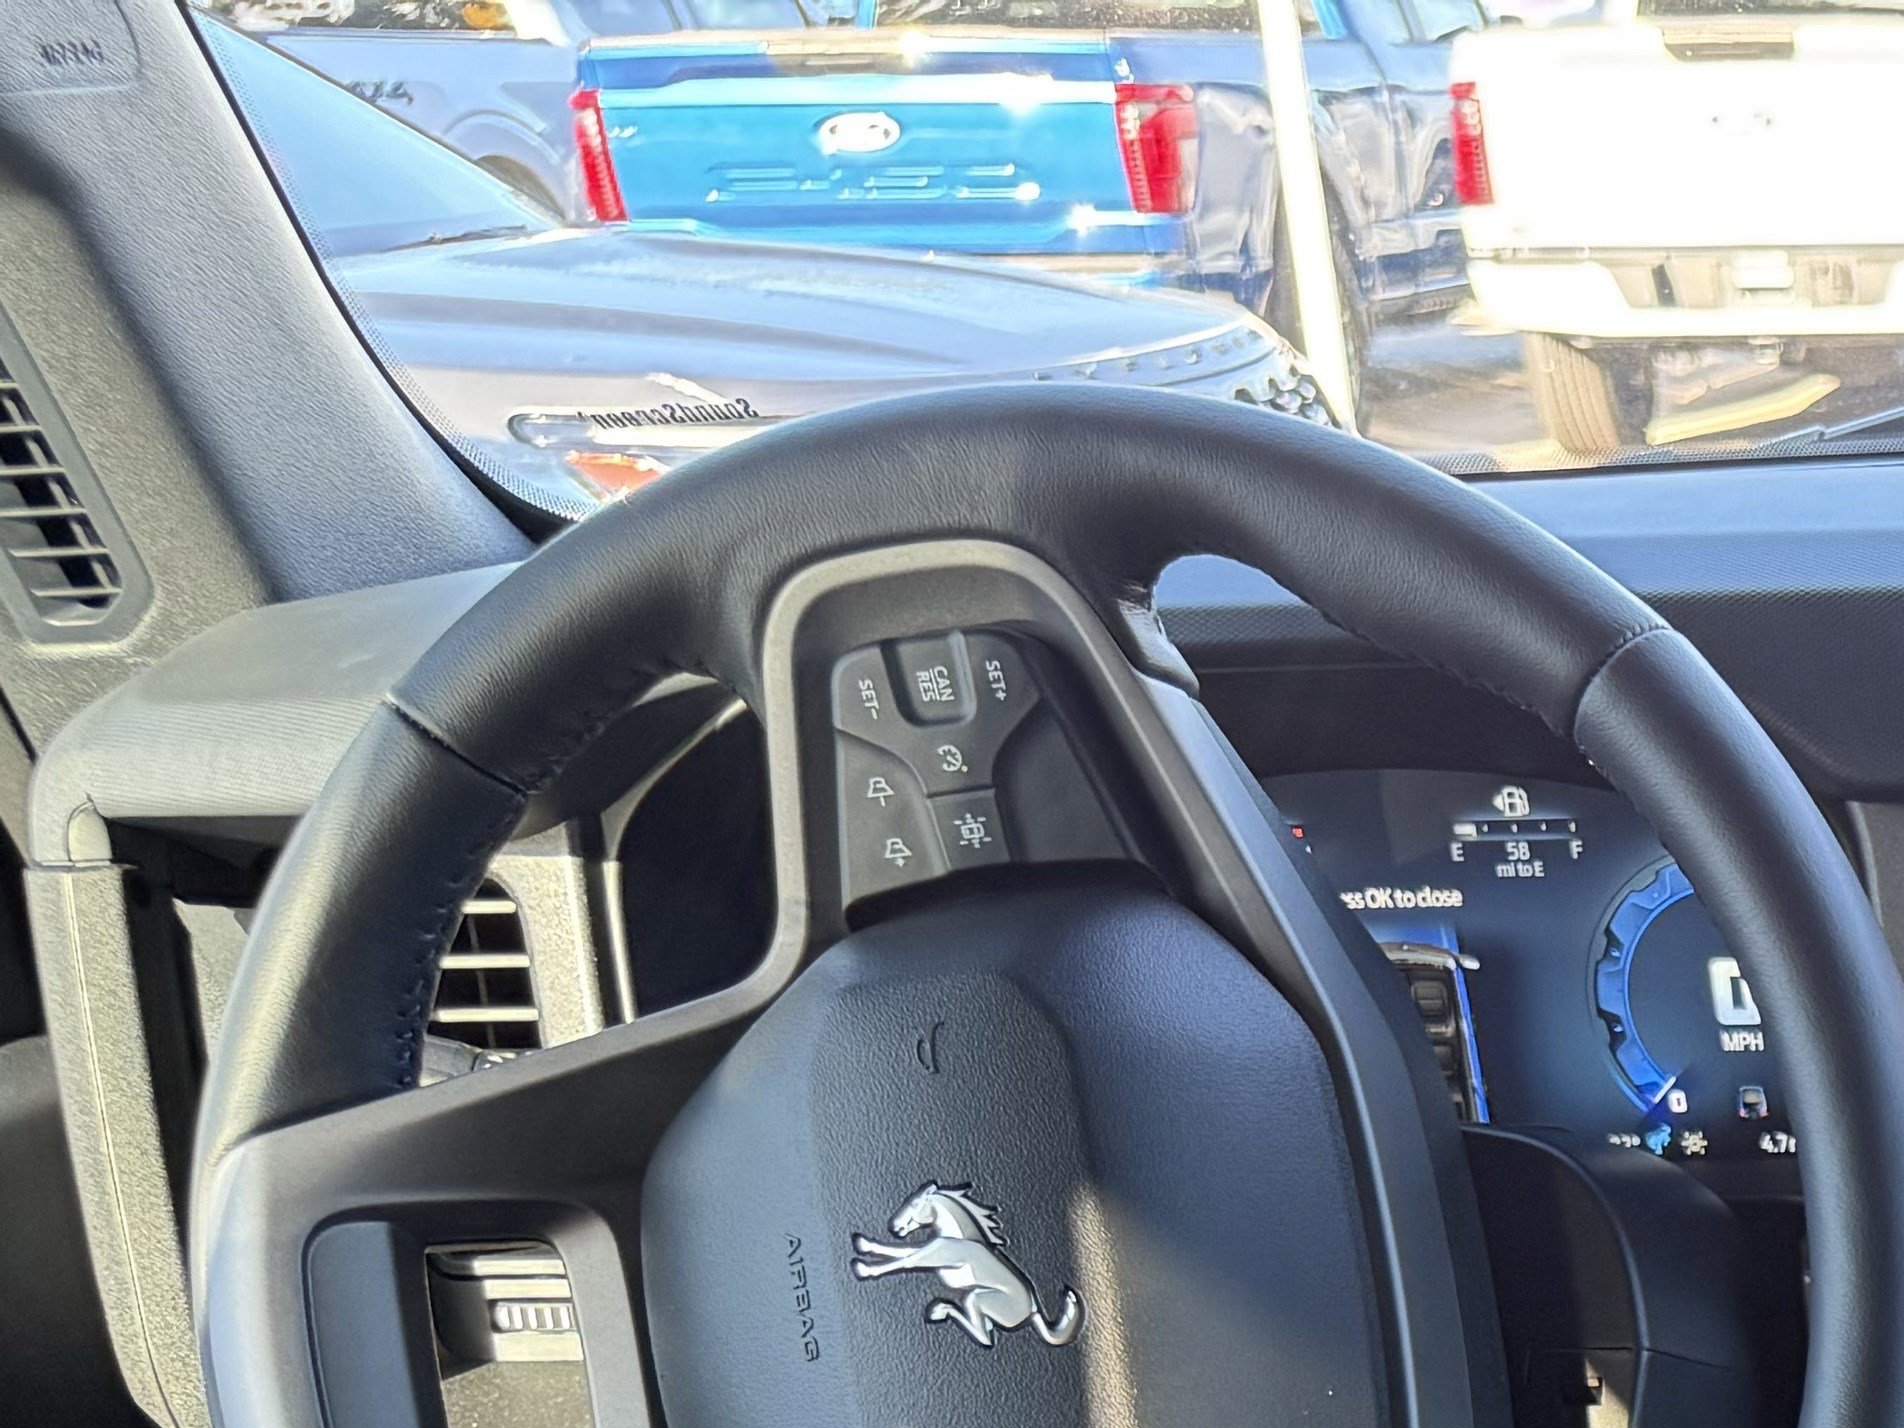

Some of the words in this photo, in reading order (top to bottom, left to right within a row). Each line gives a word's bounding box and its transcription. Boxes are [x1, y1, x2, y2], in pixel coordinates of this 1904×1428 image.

[915, 670, 932, 701] RES
[935, 666, 954, 701] CAN
[1451, 842, 1464, 861] E
[1505, 842, 1530, 860] 58
[1570, 841, 1582, 859] F
[1365, 888, 1394, 908] OK
[1416, 885, 1464, 907] close
[1720, 1030, 1765, 1052] MPH
[785, 1233, 820, 1362] AIRBAG
